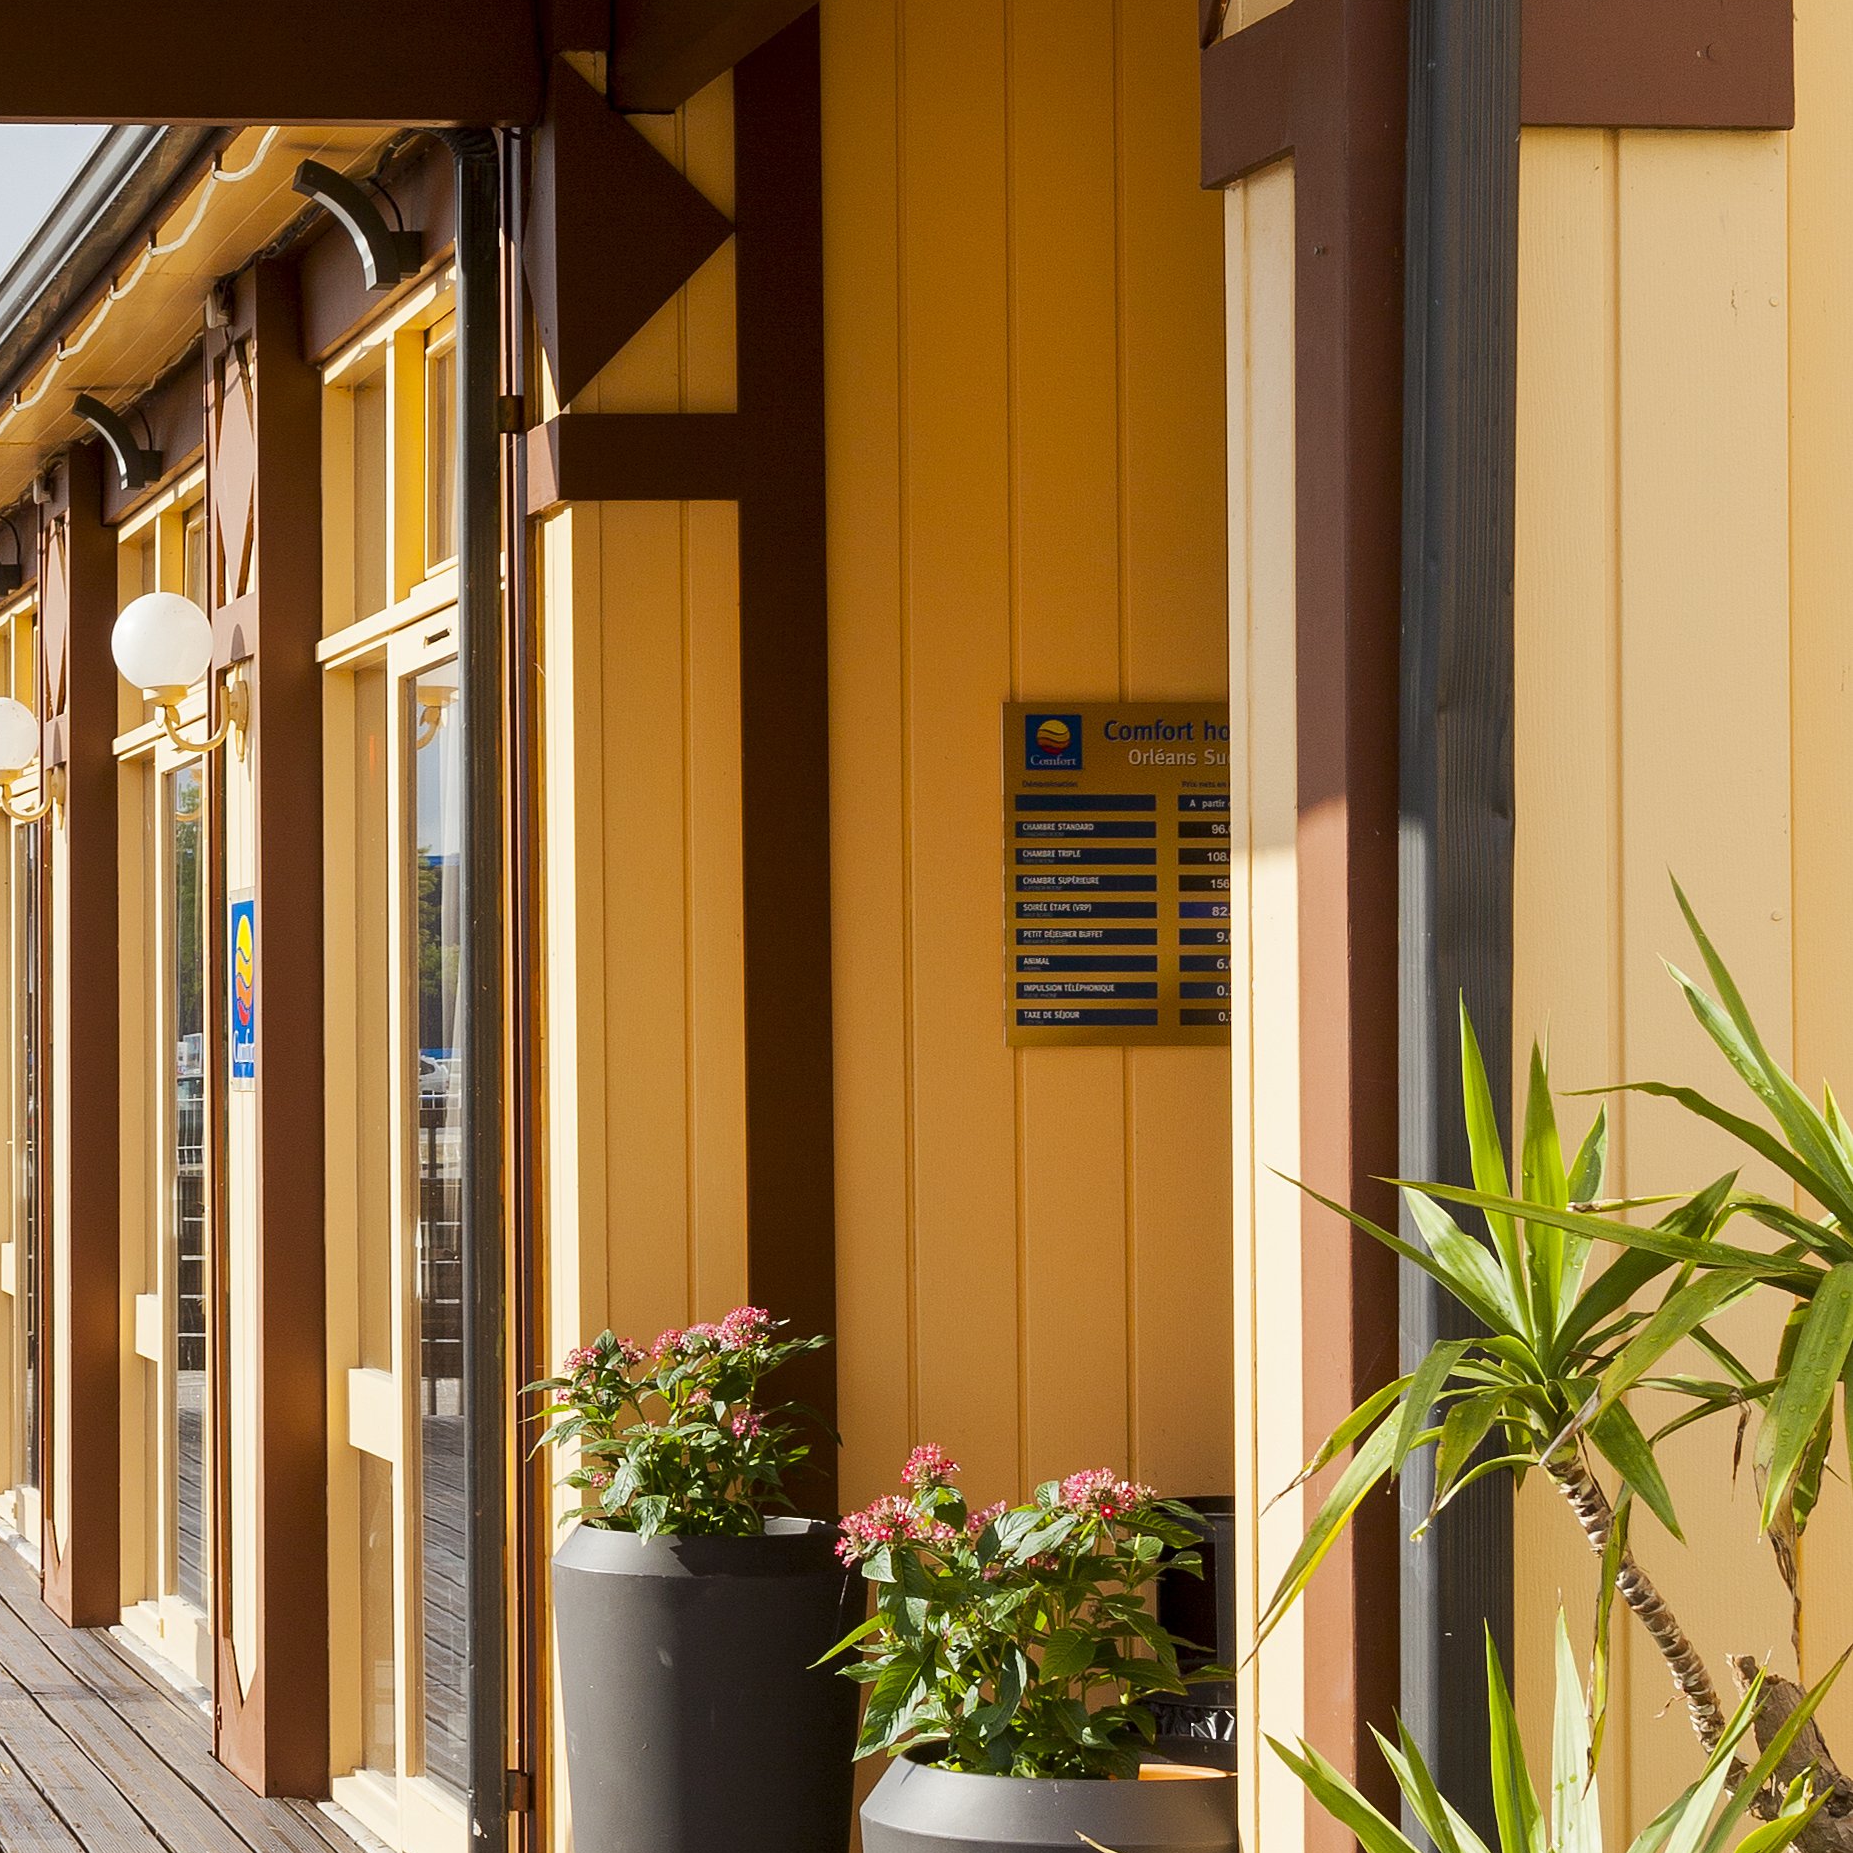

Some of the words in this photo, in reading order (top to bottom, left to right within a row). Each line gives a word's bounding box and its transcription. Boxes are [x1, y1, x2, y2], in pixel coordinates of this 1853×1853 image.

[1104, 719, 1194, 742] Comfort
[1030, 753, 1077, 766] Comfort
[1128, 748, 1196, 766] Orléans
[1202, 799, 1225, 810] partir
[1022, 823, 1055, 831] CHAMBRE
[1057, 823, 1094, 831] STANDARD
[1022, 849, 1055, 858] CHAMBRE
[1058, 849, 1081, 858] TRIPLE
[1022, 876, 1055, 885] CHAMBRE
[1058, 876, 1099, 885] SUPÉRIEURE
[1022, 903, 1048, 912] SOIRÉE
[1050, 903, 1071, 912] ÉTAPE
[1023, 930, 1043, 938] PETIT
[1023, 957, 1050, 965] ANIMAL
[1023, 984, 1063, 992] IMPULSION
[1024, 1011, 1041, 1019] TAXE
[1042, 1011, 1053, 1019] DE
[1054, 1010, 1080, 1020] SÉJOUR
